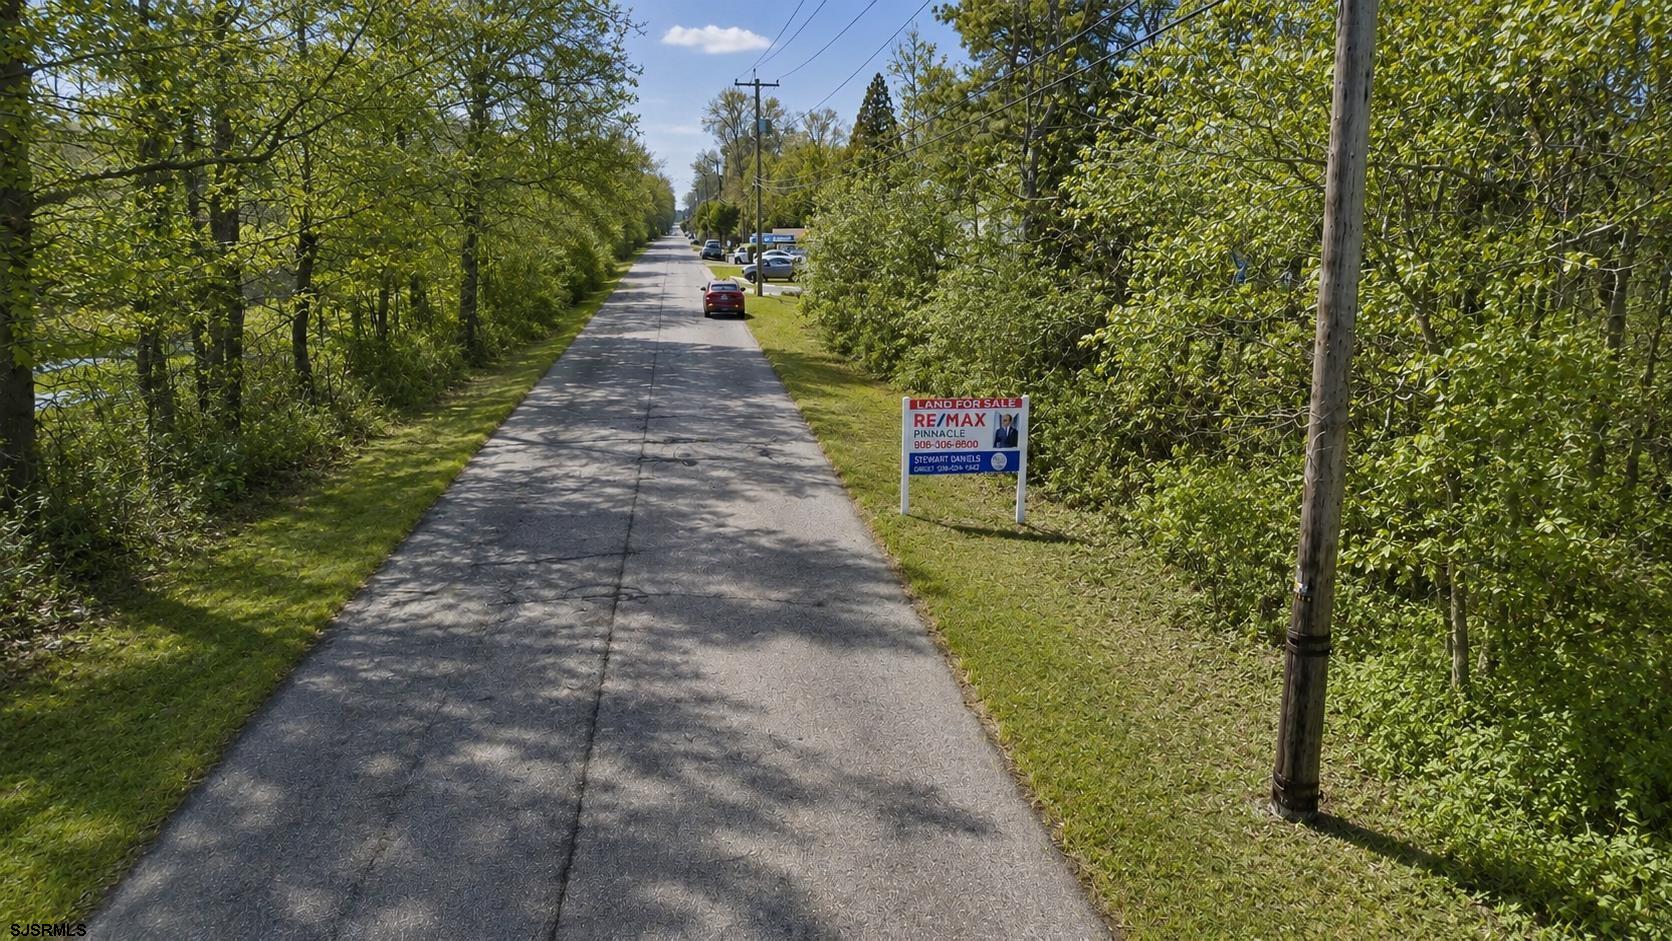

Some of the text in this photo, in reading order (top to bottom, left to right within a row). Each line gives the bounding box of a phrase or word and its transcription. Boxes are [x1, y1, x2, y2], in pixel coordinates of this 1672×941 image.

[916, 399, 1016, 409] LAND FOR SALE
[914, 413, 986, 427] RE/MAX
[914, 429, 965, 439] PINNACLE
[914, 455, 949, 464] STEWART
[951, 454, 981, 463] DANIELS
